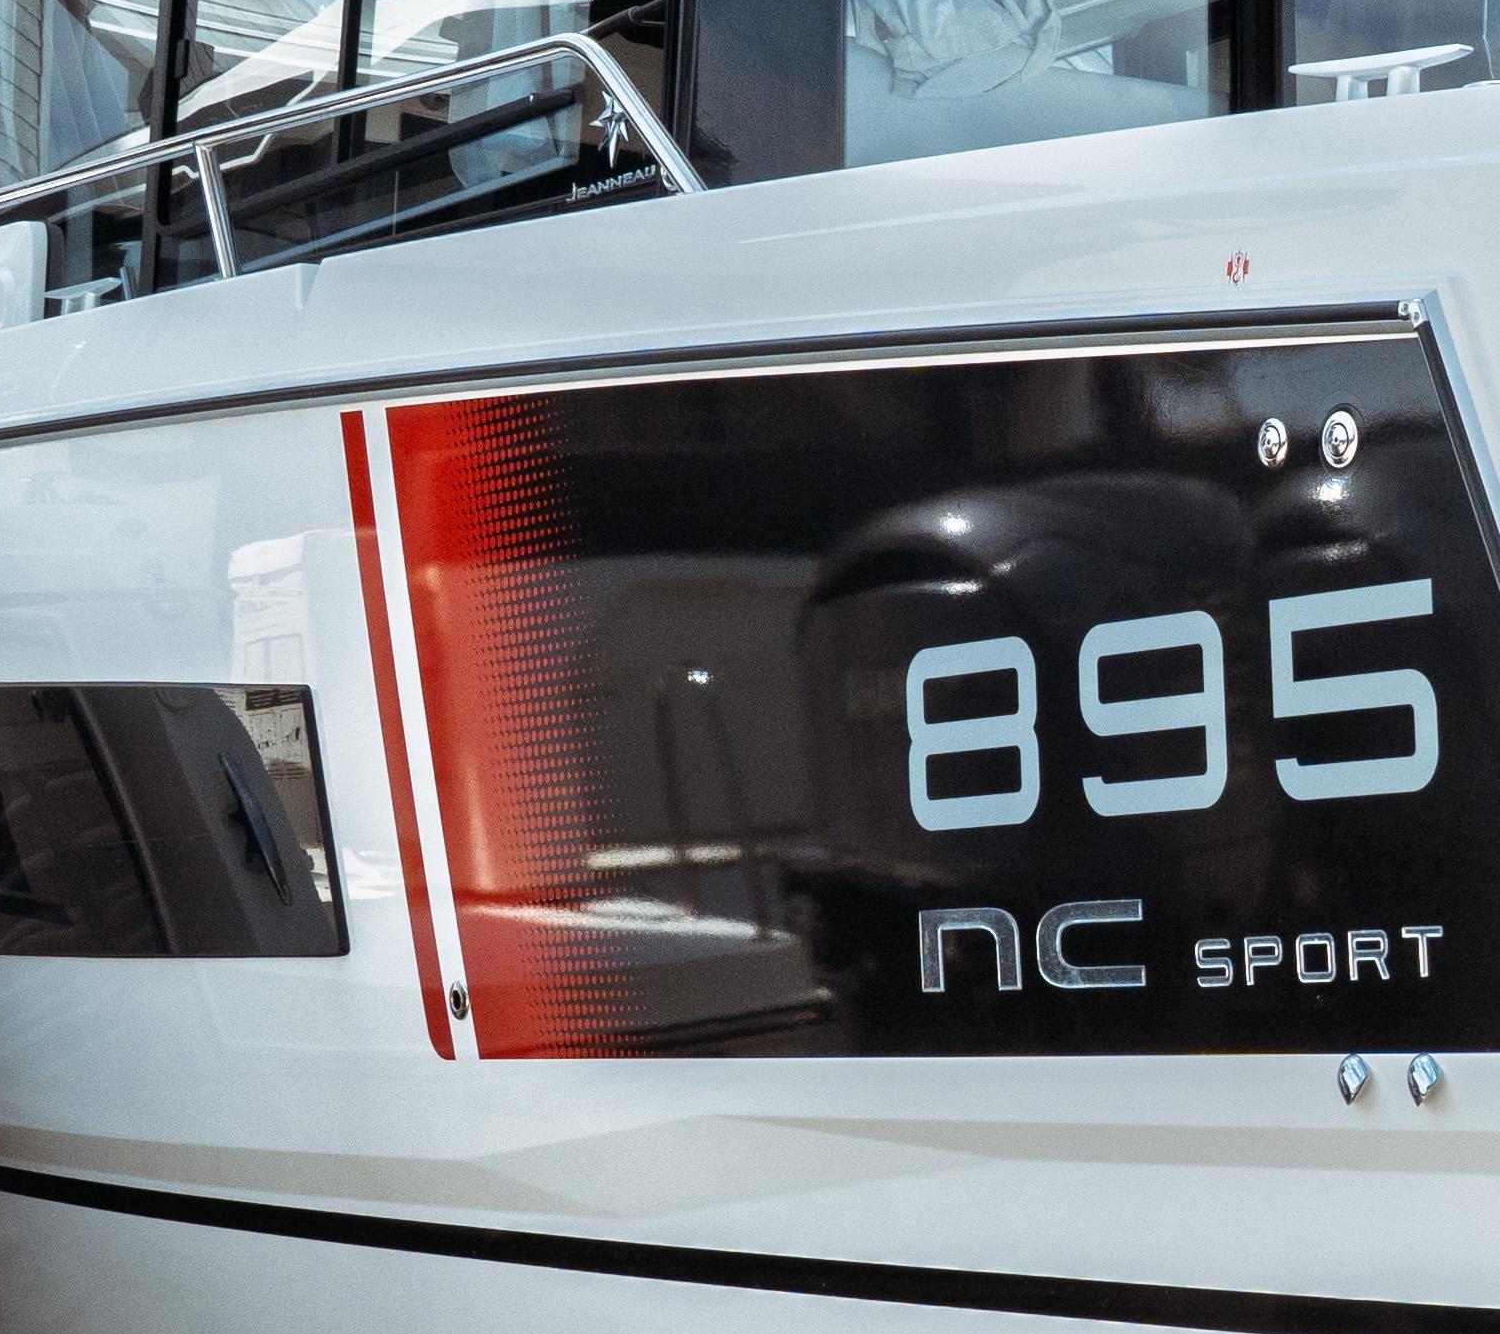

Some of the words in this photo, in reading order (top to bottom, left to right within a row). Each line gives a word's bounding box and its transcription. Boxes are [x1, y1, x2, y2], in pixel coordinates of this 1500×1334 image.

[565, 164, 657, 204] JEANNEAU
[905, 578, 1439, 832] 895
[1193, 924, 1444, 989] SPORT
